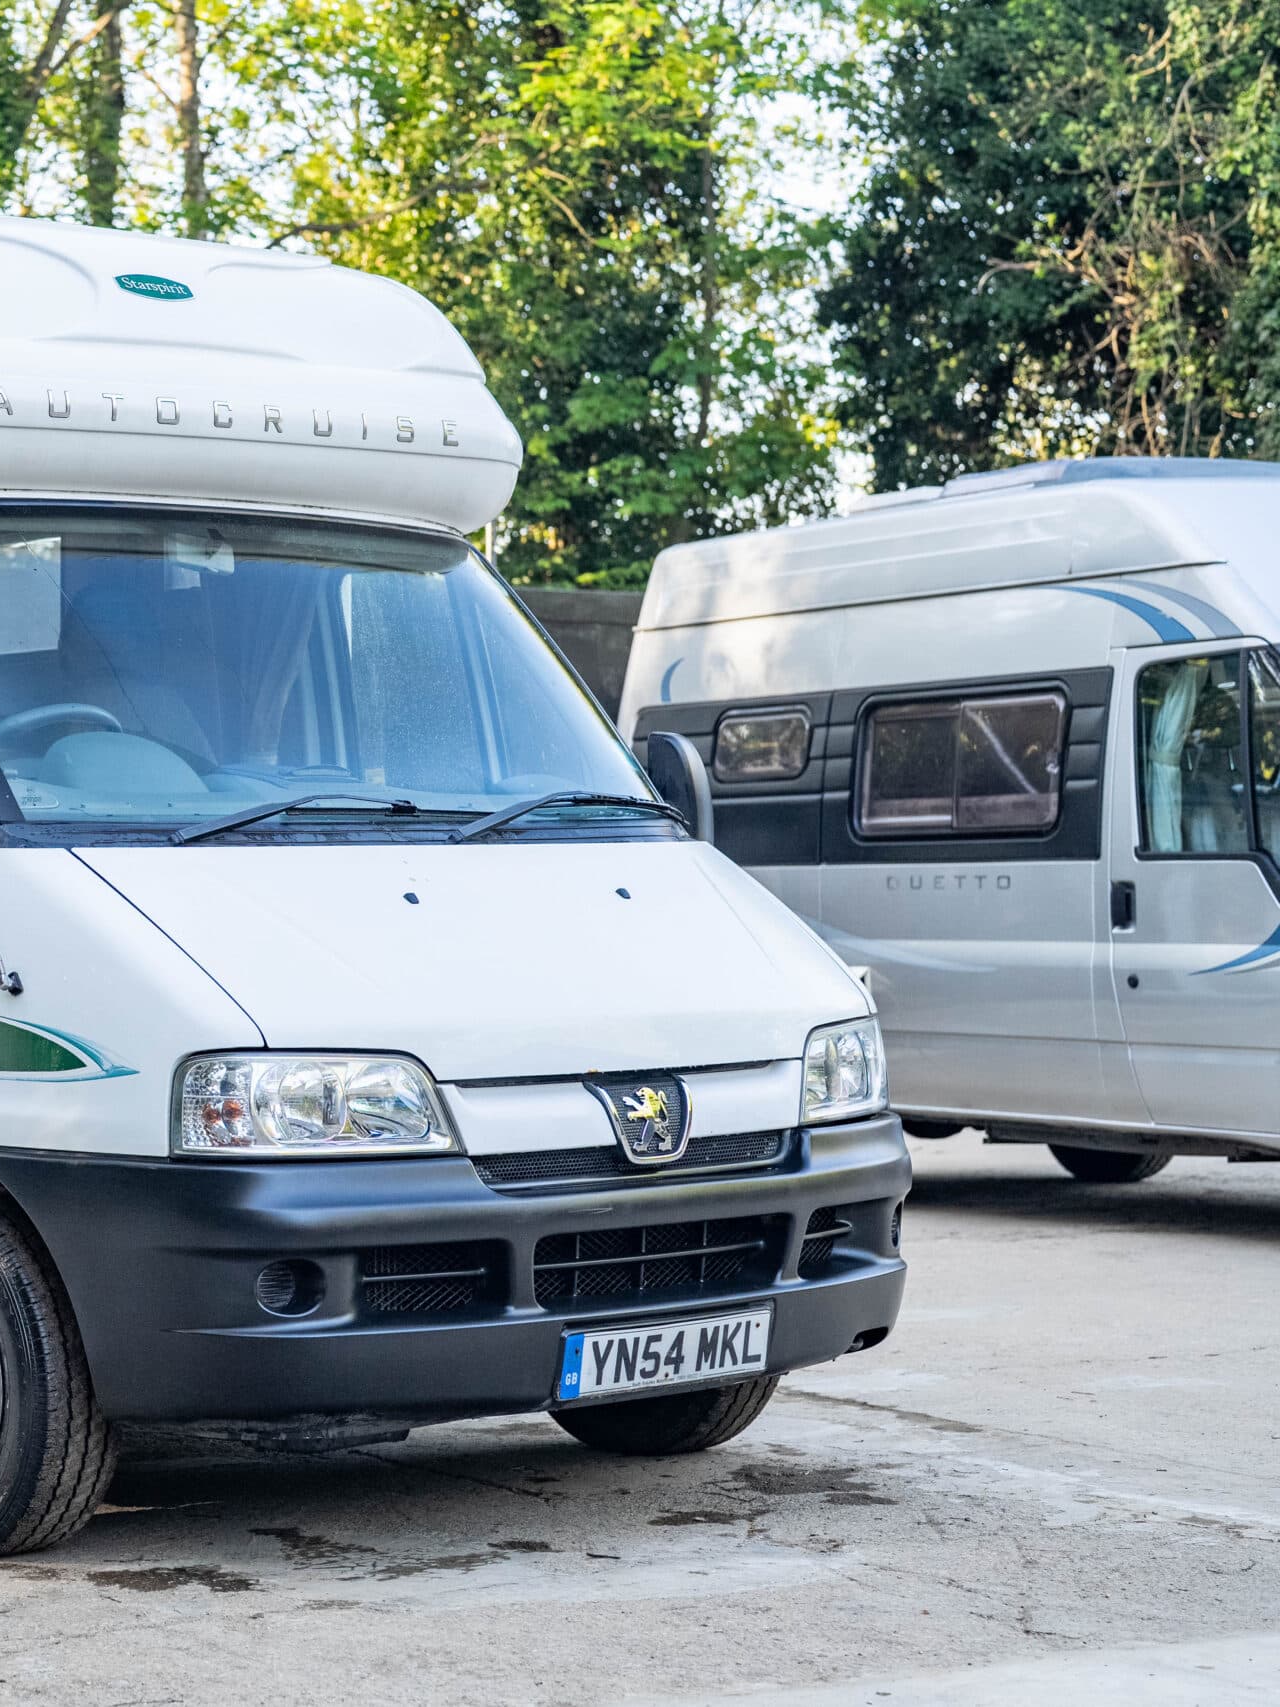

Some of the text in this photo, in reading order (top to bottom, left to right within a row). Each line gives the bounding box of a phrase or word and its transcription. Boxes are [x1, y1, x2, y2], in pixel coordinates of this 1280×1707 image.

[120, 276, 188, 295] Starspirit
[886, 874, 1011, 891] DUETTO
[591, 1320, 762, 1386] YN54 MKL
[564, 1371, 578, 1386] GB
